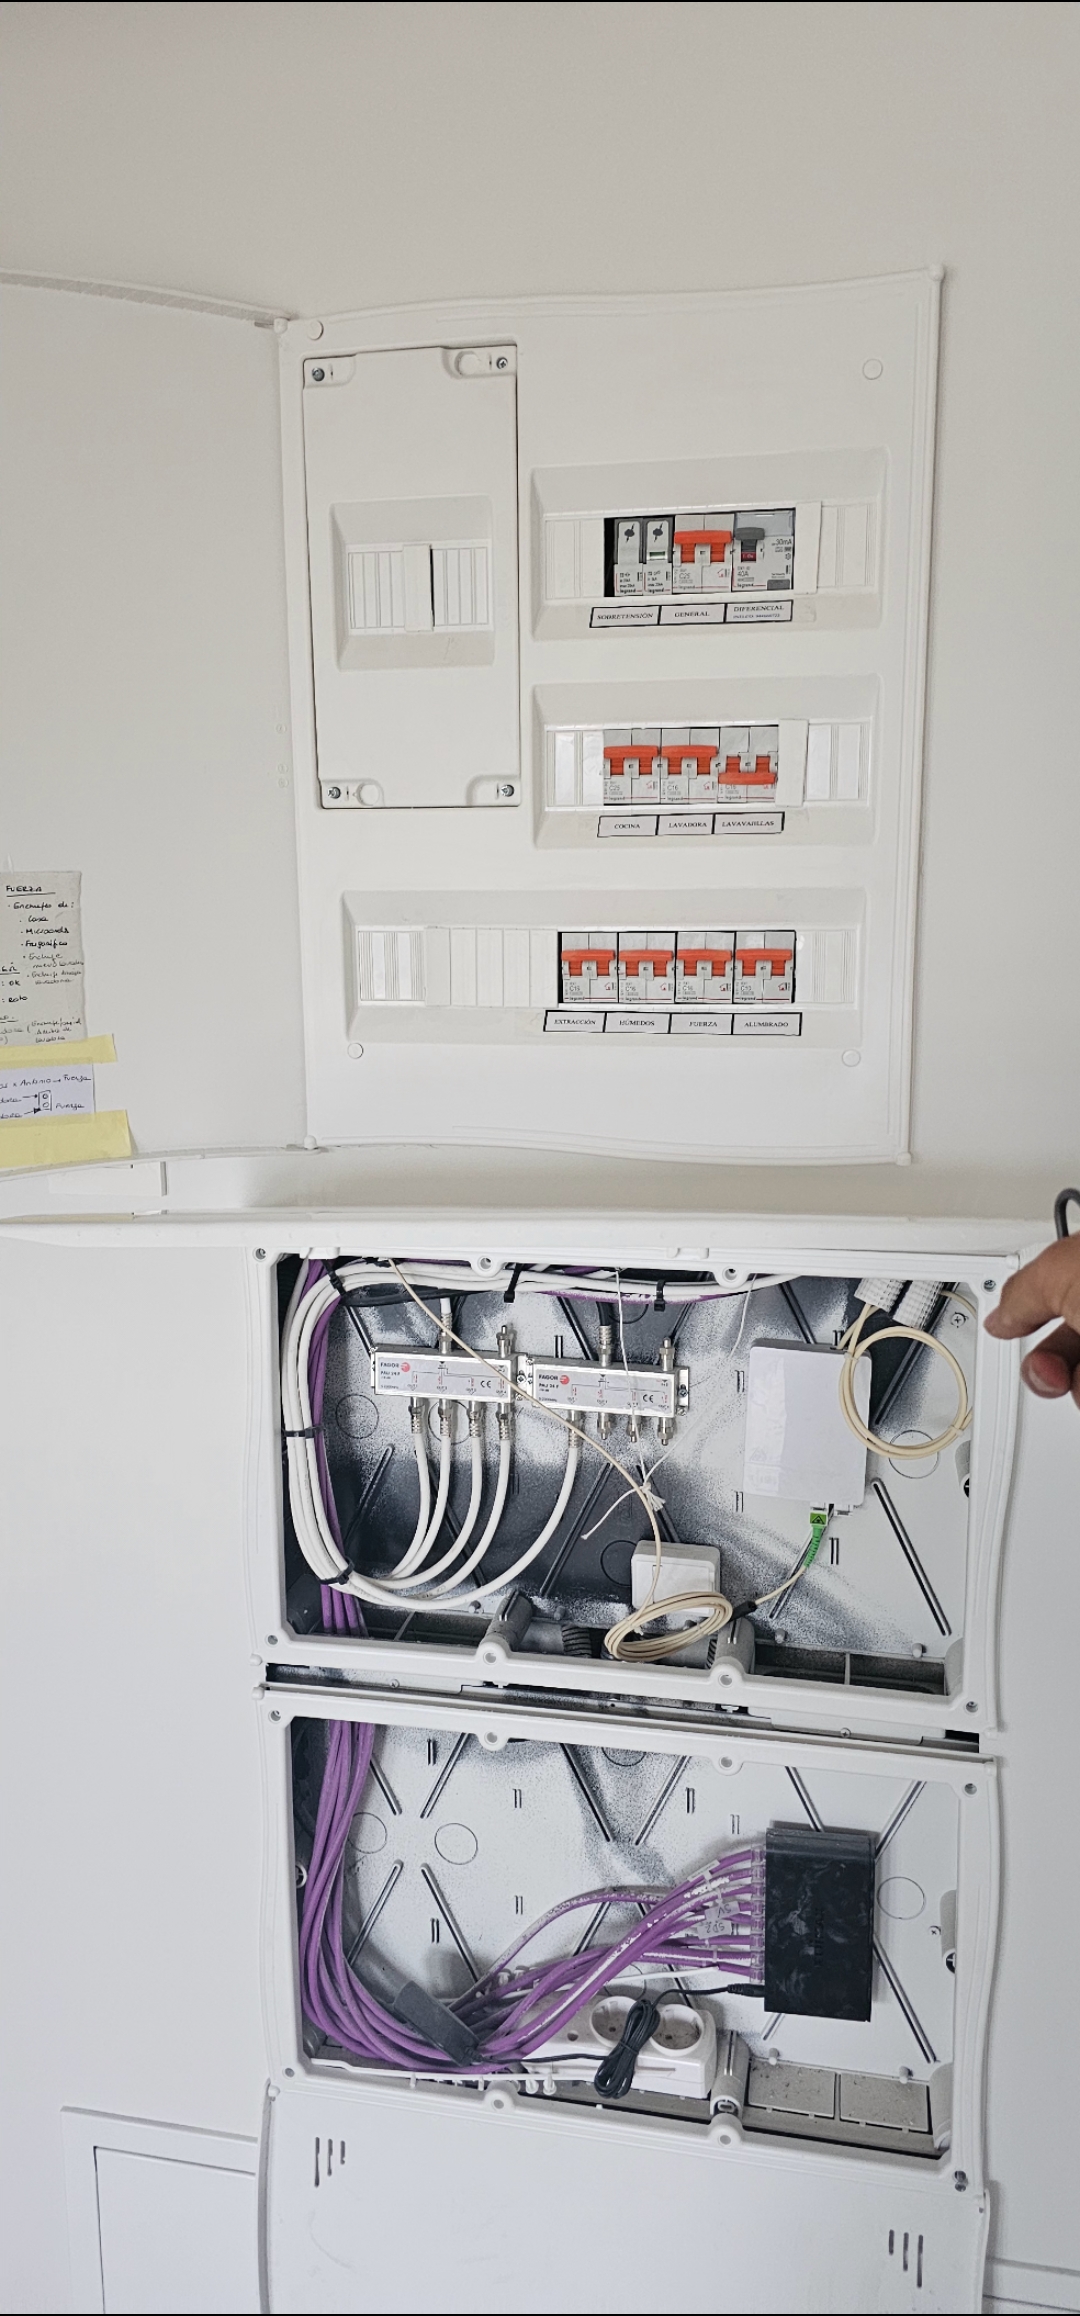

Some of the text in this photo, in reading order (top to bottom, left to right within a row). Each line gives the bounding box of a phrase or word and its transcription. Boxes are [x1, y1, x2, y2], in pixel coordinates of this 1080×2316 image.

[596, 612, 654, 621] SOBRETENSIÓN
[668, 821, 707, 829] LAVADORA
[554, 1018, 597, 1026] EXTRACCIÓN
[619, 1019, 655, 1027] HÚMEDOS
